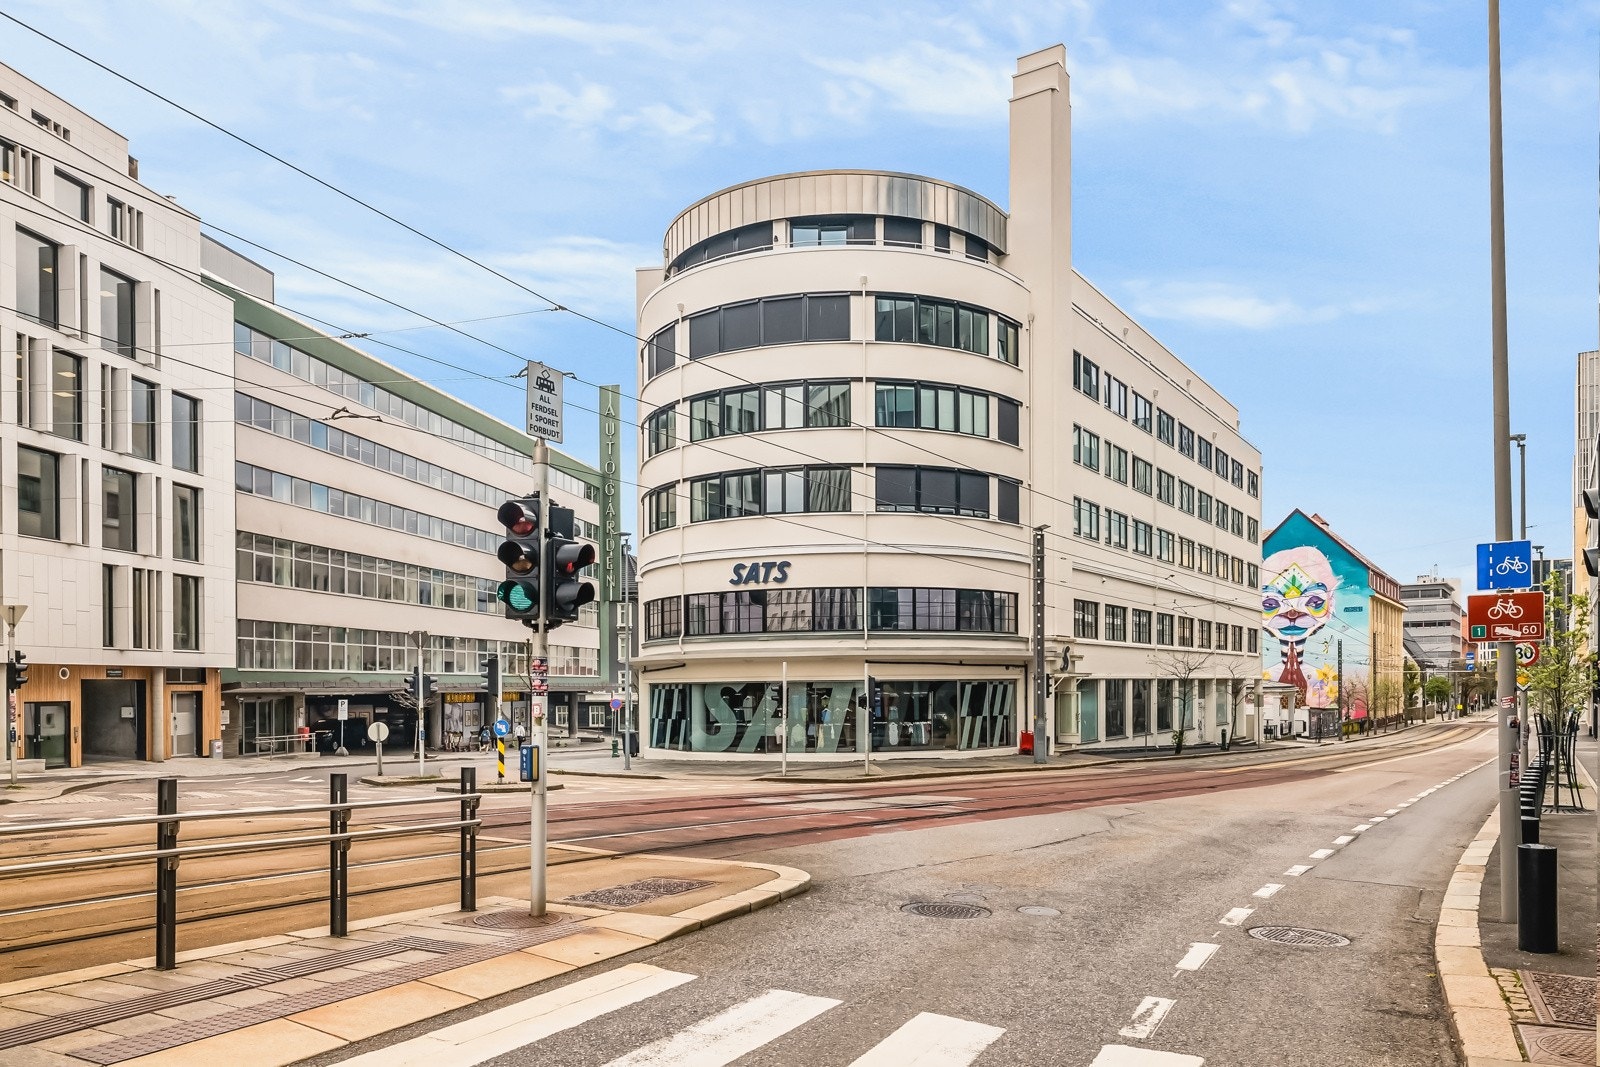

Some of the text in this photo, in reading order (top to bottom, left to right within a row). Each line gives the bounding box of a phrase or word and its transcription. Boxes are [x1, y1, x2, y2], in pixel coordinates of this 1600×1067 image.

[539, 394, 551, 405] ALL
[531, 402, 559, 418] FERDSEL
[535, 414, 560, 428] SPORET
[529, 423, 560, 439] FORBUDT
[728, 560, 792, 586] SATS
[1476, 625, 1537, 636] 1 60
[1515, 647, 1534, 660] 30
[340, 700, 346, 708] P
